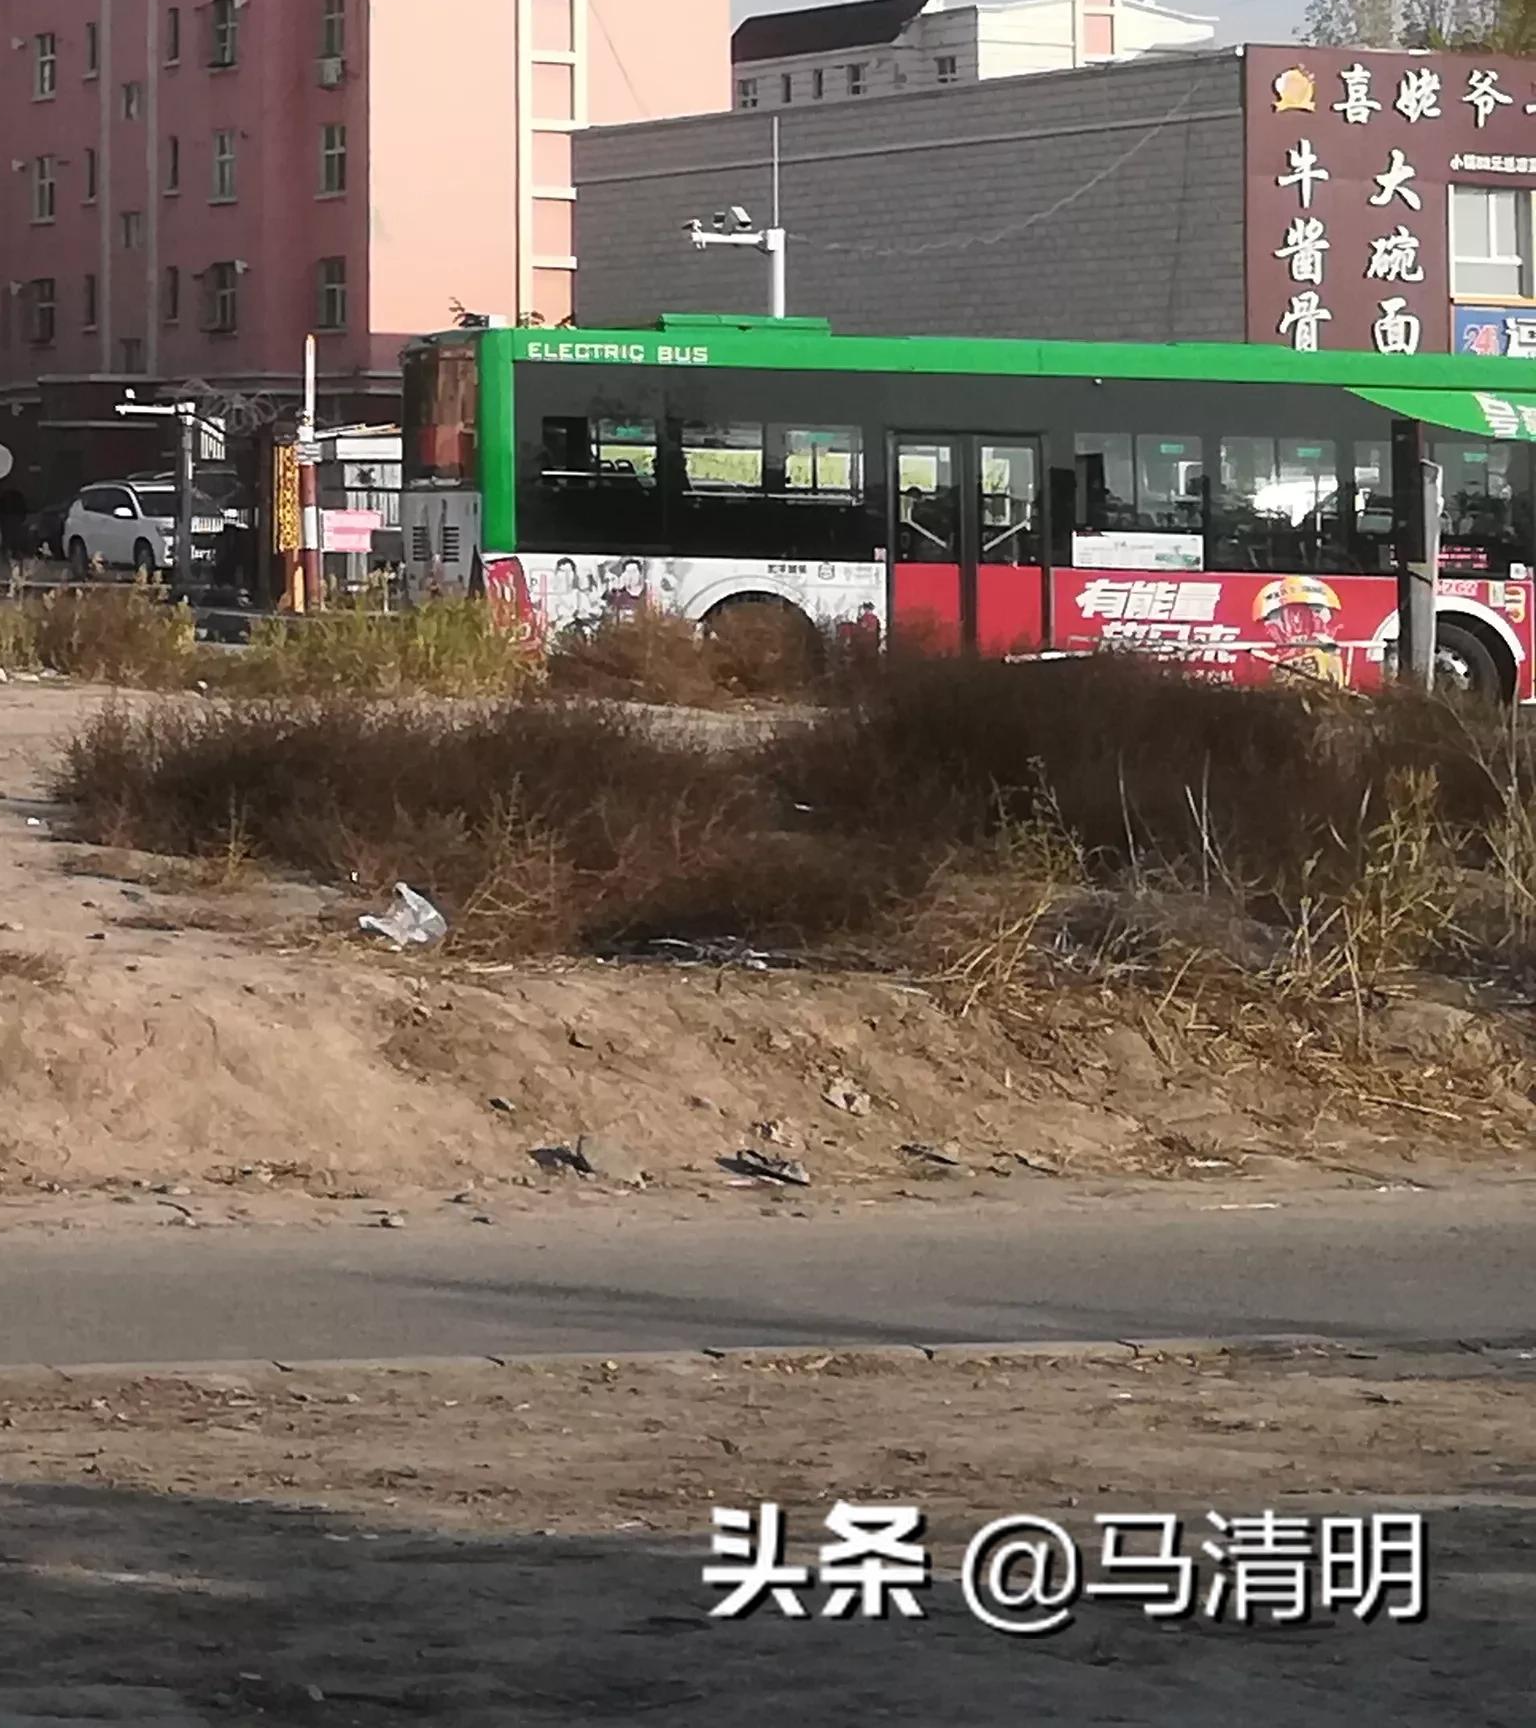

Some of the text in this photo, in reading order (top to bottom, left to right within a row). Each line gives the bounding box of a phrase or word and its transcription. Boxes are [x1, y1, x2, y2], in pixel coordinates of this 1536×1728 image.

[1333, 63, 1536, 129] 喜姥爷
[1274, 138, 1332, 351] 牛酱骨
[1367, 149, 1424, 355] 大碗面
[527, 341, 708, 364] ELECTRIC BUS
[1075, 578, 1222, 622] 有能量
